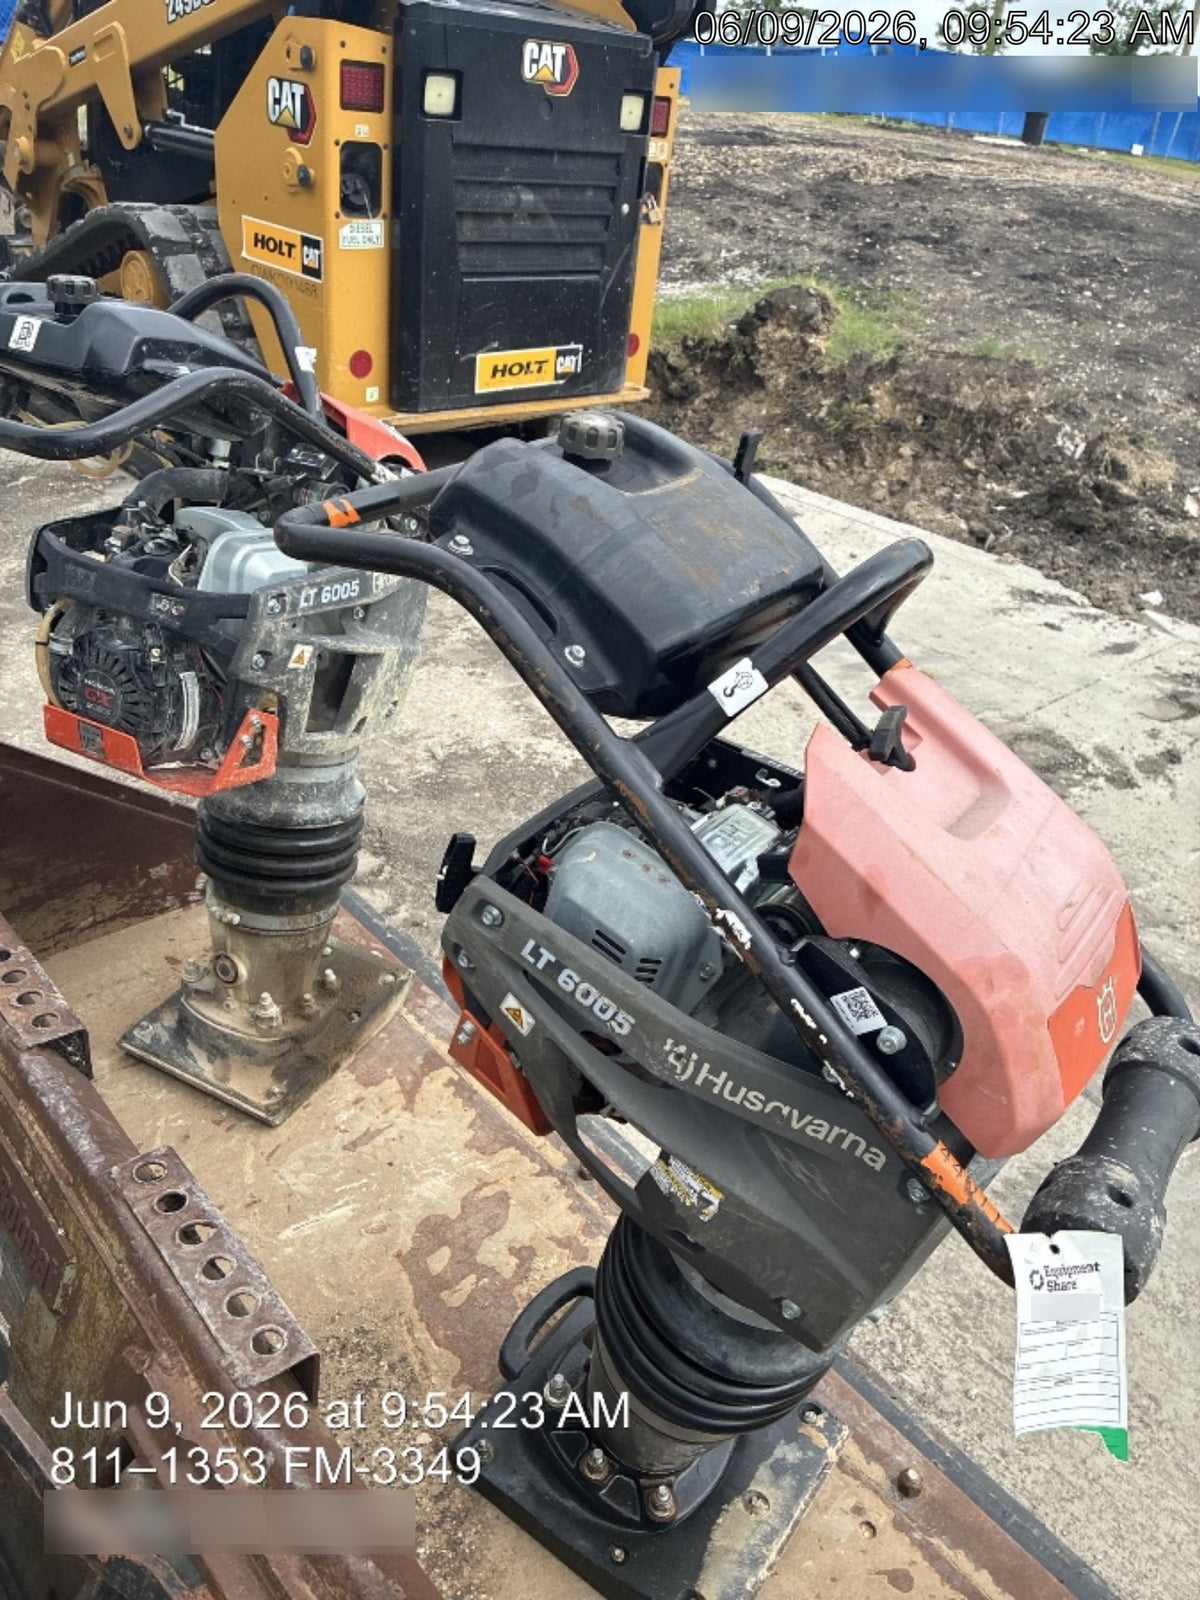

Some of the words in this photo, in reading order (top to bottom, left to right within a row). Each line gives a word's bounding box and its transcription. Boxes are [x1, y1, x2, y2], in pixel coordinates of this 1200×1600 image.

[523, 41, 567, 82] CAT
[267, 77, 305, 129] CAT
[253, 232, 297, 260] HOLT
[303, 244, 321, 270] CAT
[490, 359, 549, 379] HOLT
[556, 354, 577, 374] CAT
[300, 587, 318, 608] LT
[321, 579, 360, 603] 6005
[520, 938, 556, 970] LT
[557, 968, 636, 1036] 6005
[1043, 1261, 1101, 1280] Equipment
[1046, 1280, 1078, 1293] Share
